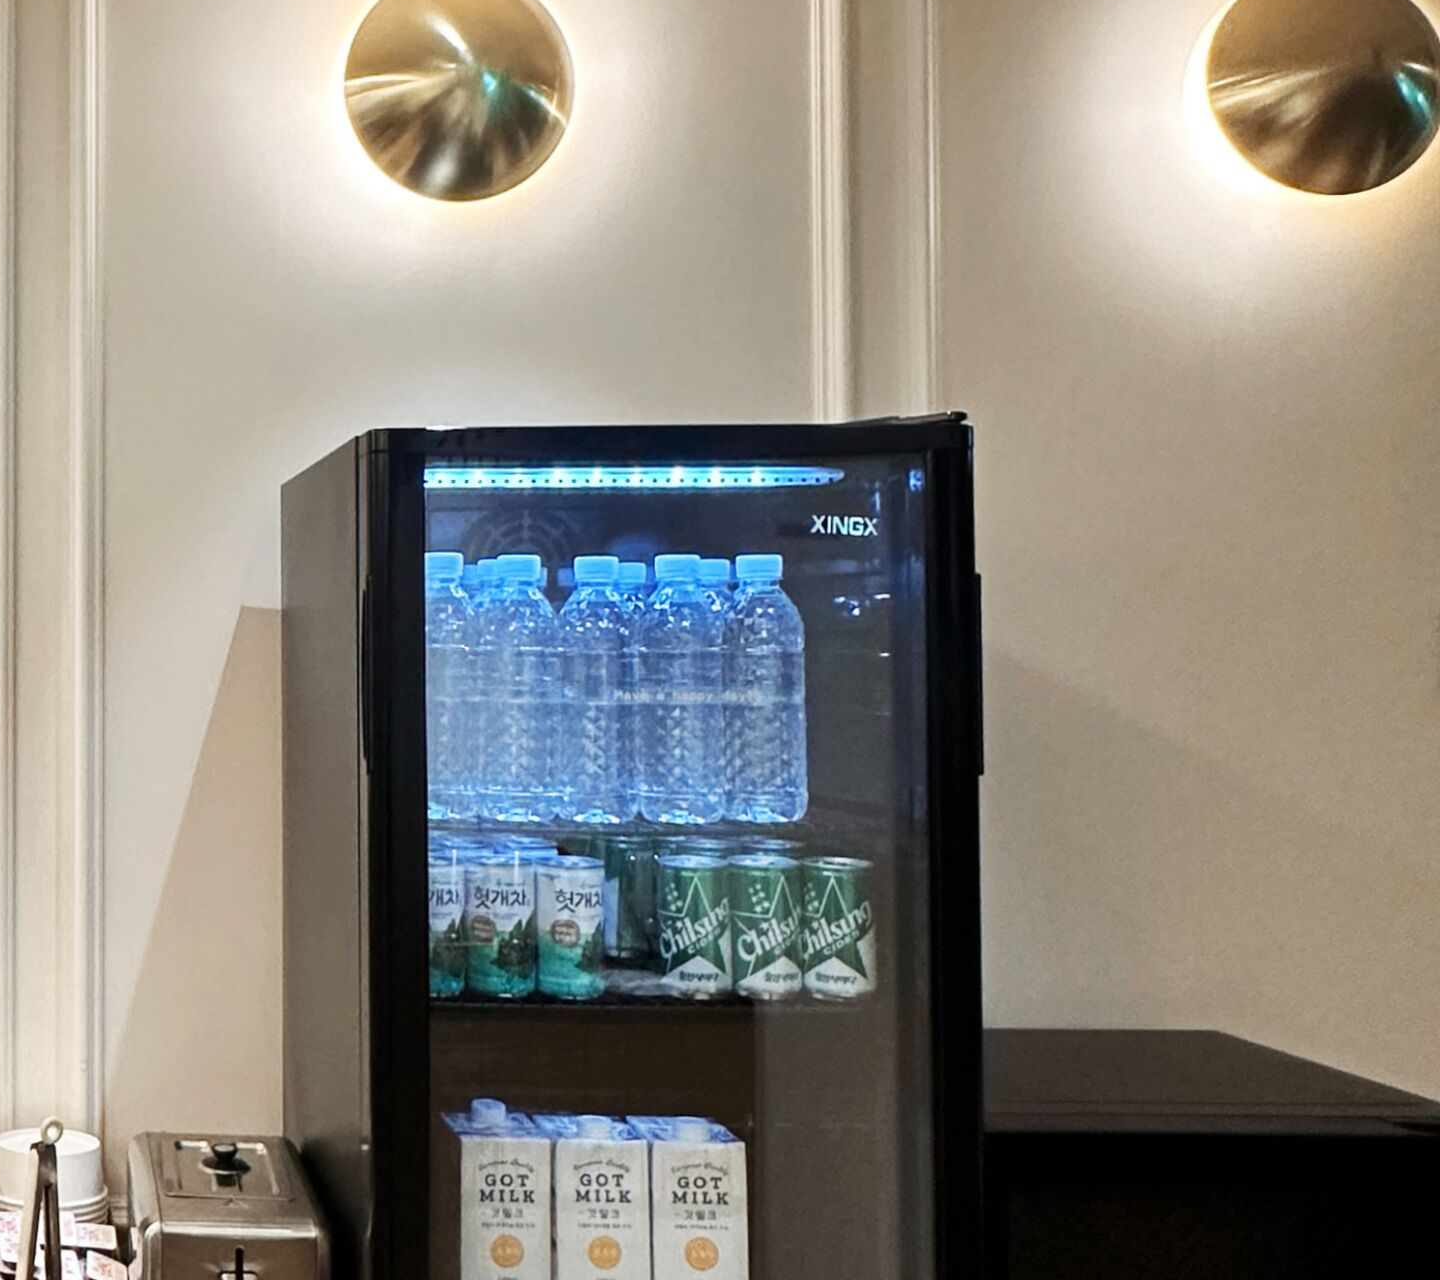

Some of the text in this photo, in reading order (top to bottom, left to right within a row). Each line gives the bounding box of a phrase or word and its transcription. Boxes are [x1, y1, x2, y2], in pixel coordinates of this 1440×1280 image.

[809, 514, 879, 536] XINGX
[474, 885, 527, 909] 헛개차
[484, 1173, 530, 1188] GOT
[579, 1173, 625, 1188] GOT
[676, 1176, 723, 1190] GOT
[479, 1189, 535, 1204] MILK
[575, 1189, 632, 1204] MILK
[671, 1190, 730, 1206] MILK
